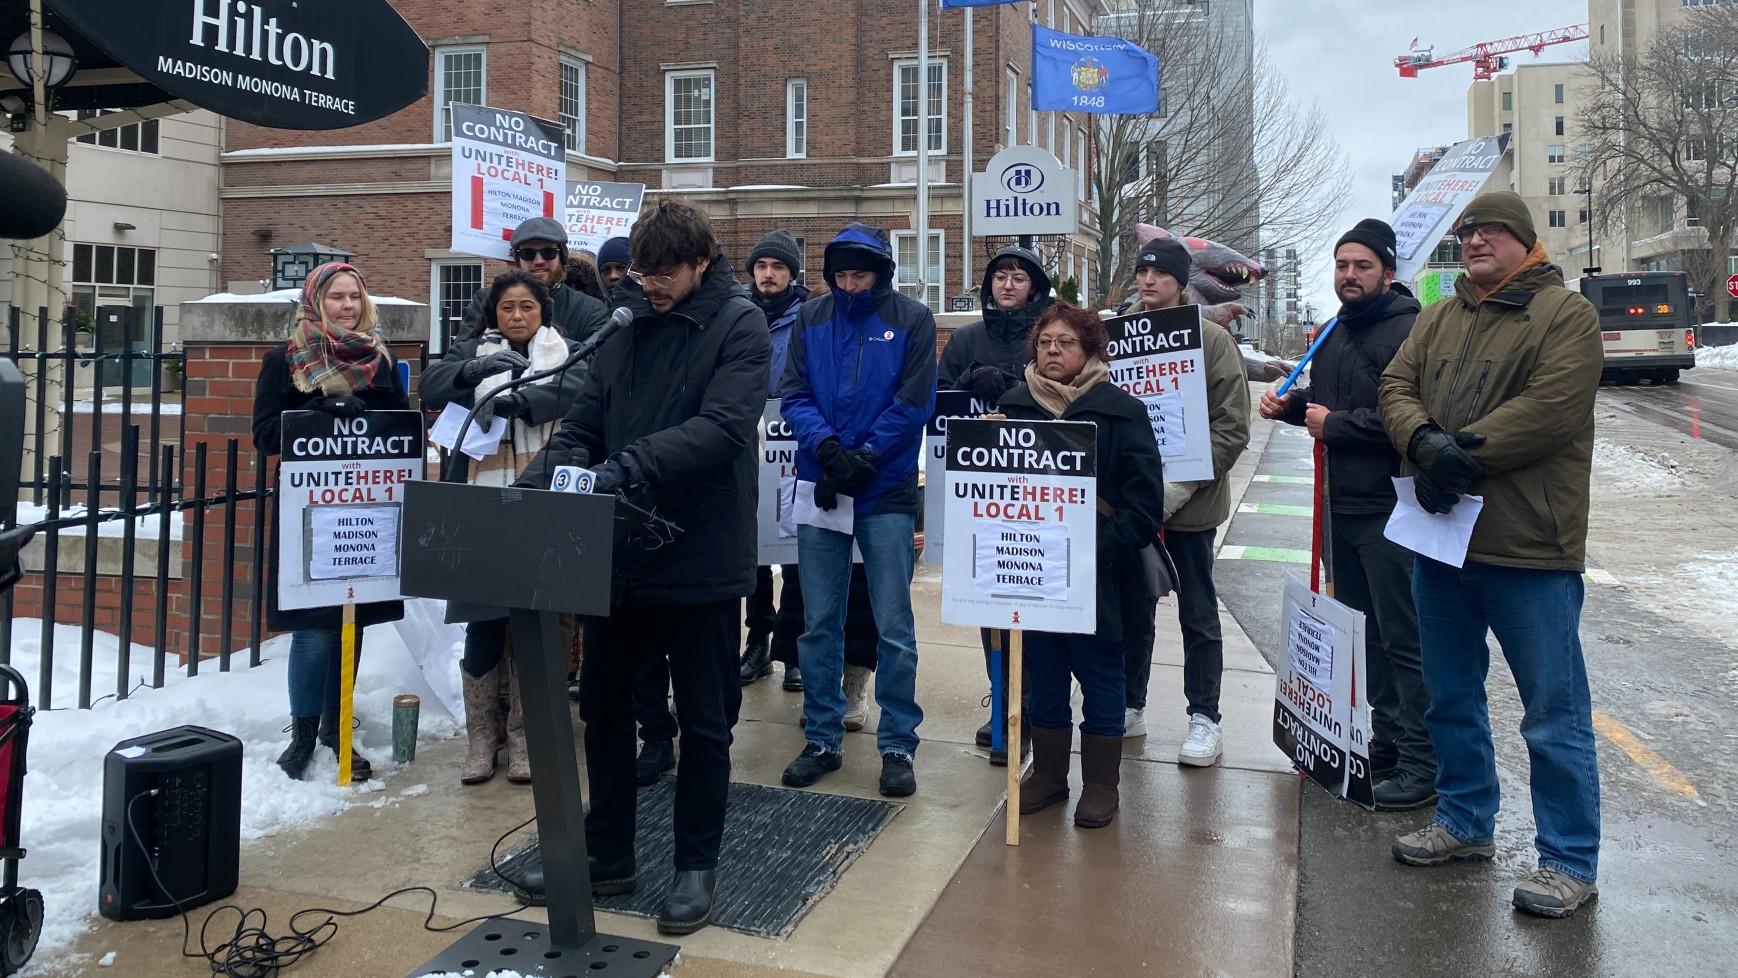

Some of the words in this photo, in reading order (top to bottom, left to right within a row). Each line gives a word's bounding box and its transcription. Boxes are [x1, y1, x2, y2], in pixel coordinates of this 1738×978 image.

[189, 0, 336, 80] Hilton
[157, 55, 233, 87] MADISON
[237, 74, 300, 102] MONONA
[303, 89, 355, 115] TERRACE
[1072, 95, 1105, 108] 1848
[495, 113, 524, 131] NO
[462, 121, 558, 157] CONTRACT
[503, 149, 520, 158] with
[477, 163, 532, 186] LOCAL
[537, 178, 544, 190] 1
[488, 189, 512, 199] HILTON
[512, 193, 541, 206] MADISON
[575, 184, 602, 196] NO
[500, 201, 530, 213] MONONA
[984, 196, 1062, 218] Hilton
[1627, 278, 1642, 286] 993
[1124, 318, 1152, 337] NO
[1133, 357, 1149, 366] with
[1108, 359, 1195, 383] NITEHERE!
[1171, 377, 1179, 391] 1
[333, 417, 368, 435] NO
[999, 427, 1036, 447] NO
[292, 436, 413, 456] CONTRACT
[341, 461, 361, 470] with
[956, 447, 1086, 471] CONTRACT
[1007, 476, 1029, 484] with
[308, 487, 377, 505] LOCAL
[384, 486, 393, 501] 1
[954, 482, 1086, 505] UNITEHERE!
[973, 501, 1046, 521] LOCAL
[1054, 506, 1064, 522] 1
[337, 517, 374, 527] HILTON
[332, 530, 378, 540] MADISON
[1001, 532, 1041, 543] HILTON
[333, 543, 376, 553] MONONA
[995, 546, 1045, 558] MADISON
[331, 556, 377, 566] TERRACE
[997, 560, 1043, 572] MONONA
[995, 574, 1044, 586] TERRACE
[1296, 677, 1333, 715] LOCAL
[1277, 708, 1340, 768] CONTRACT
[1296, 743, 1315, 771] NO
